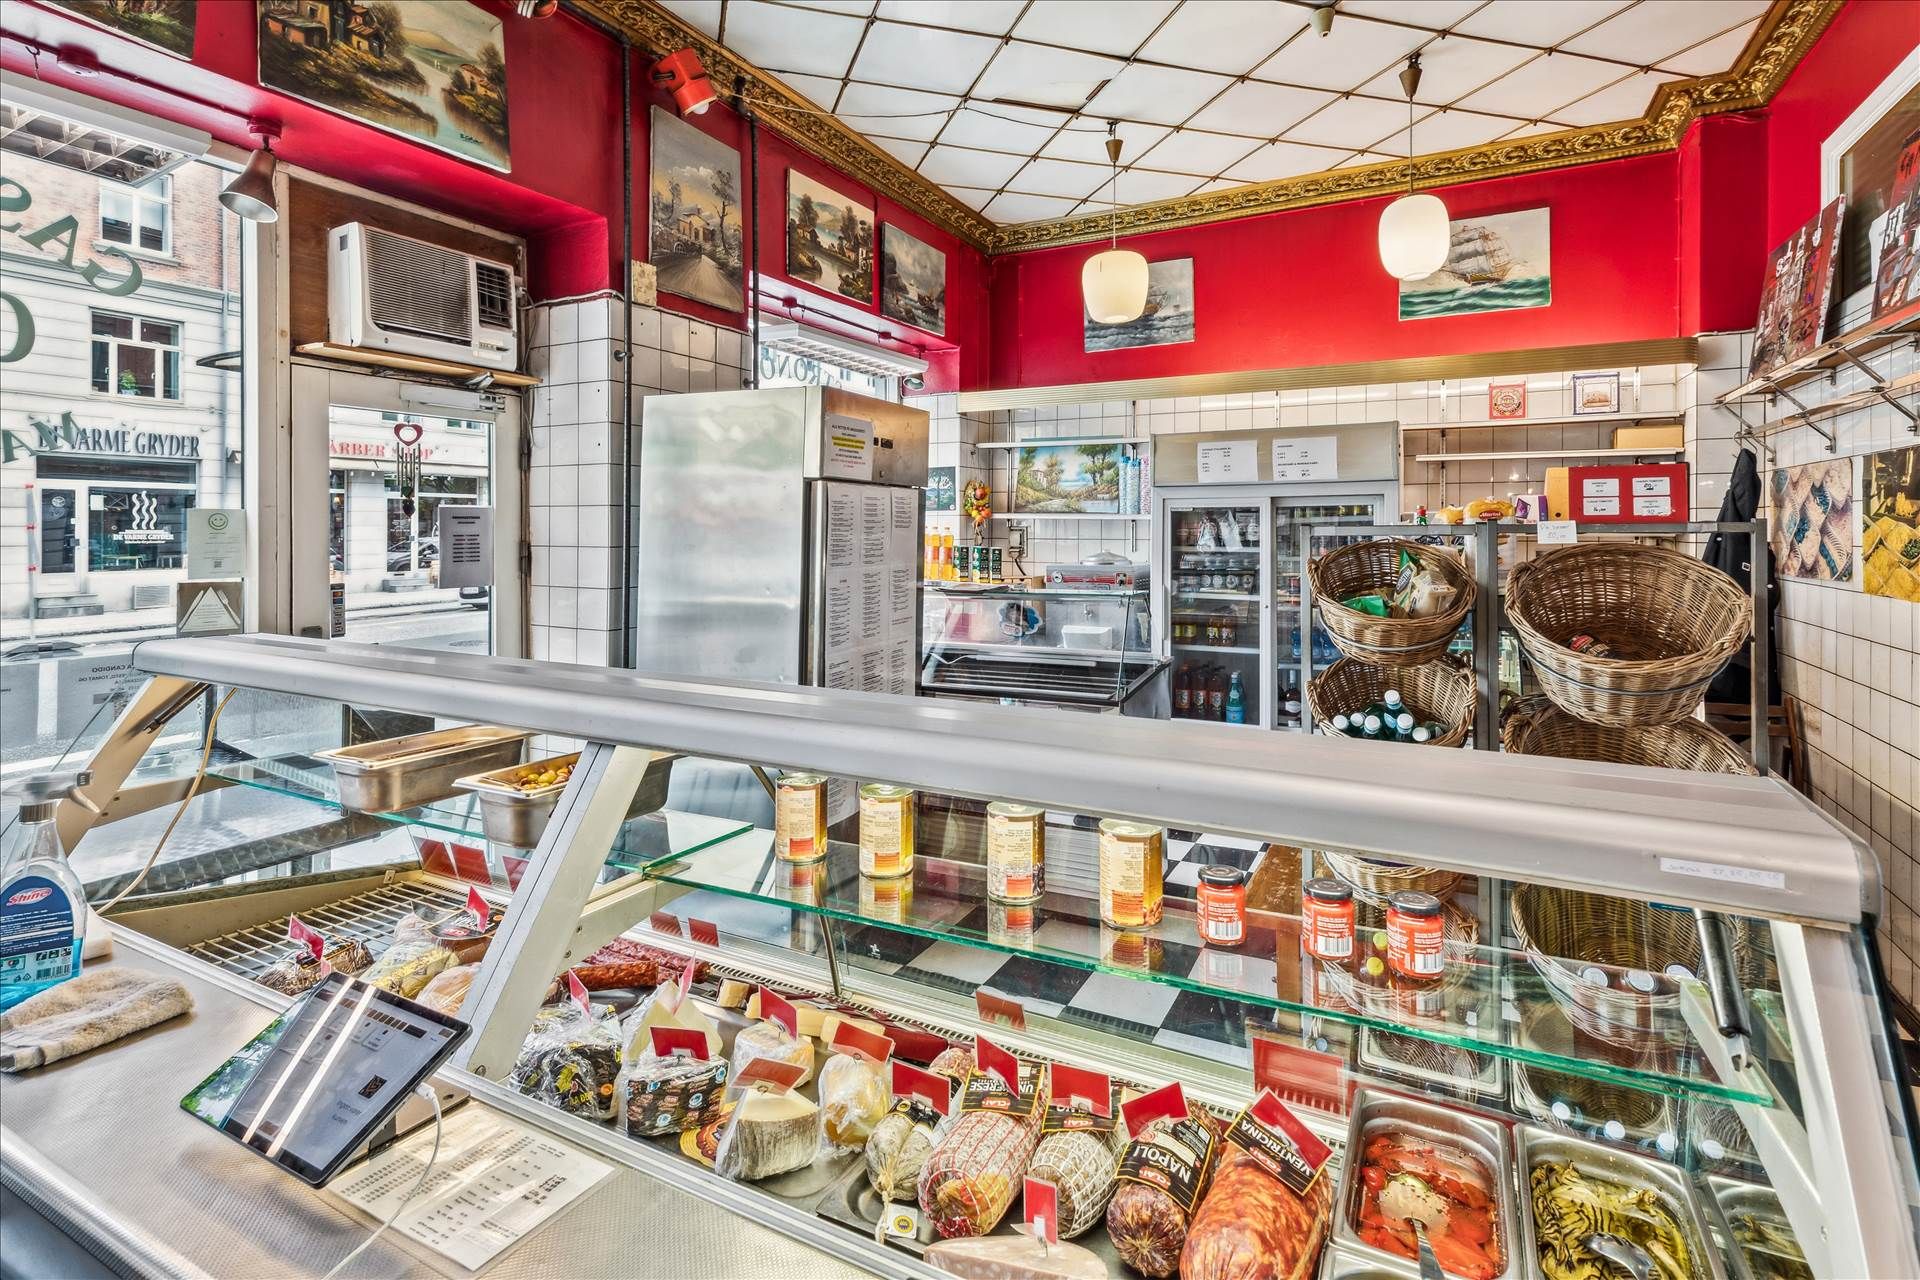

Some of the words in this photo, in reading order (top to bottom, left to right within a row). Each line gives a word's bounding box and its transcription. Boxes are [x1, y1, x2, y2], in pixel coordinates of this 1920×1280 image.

[135, 431, 201, 458] GRYDER
[8, 888, 51, 905] Shine
[1239, 1119, 1312, 1177] VENTRICINA
